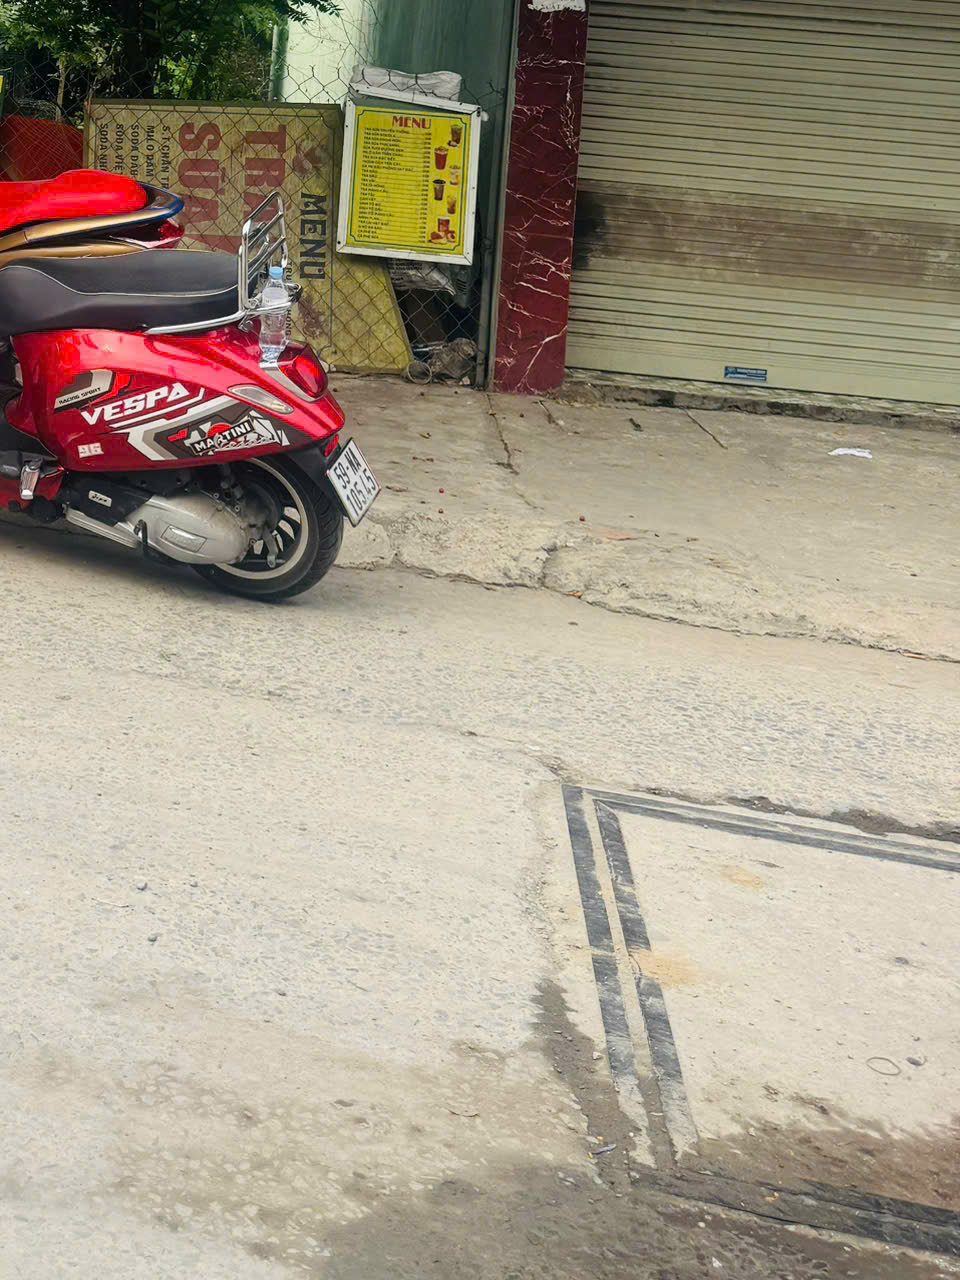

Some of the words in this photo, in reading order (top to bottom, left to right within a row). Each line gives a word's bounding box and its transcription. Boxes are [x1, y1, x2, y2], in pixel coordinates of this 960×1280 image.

[392, 115, 432, 129] MENU
[100, 123, 108, 151] SODA
[115, 123, 124, 151] SODA
[130, 124, 140, 152] SODA
[299, 192, 327, 280] MENU
[58, 394, 80, 405] RACING
[81, 387, 101, 398] SPORT
[80, 382, 190, 426] VESPA
[193, 421, 252, 452] MARTINI
[346, 468, 377, 517] 105.45
